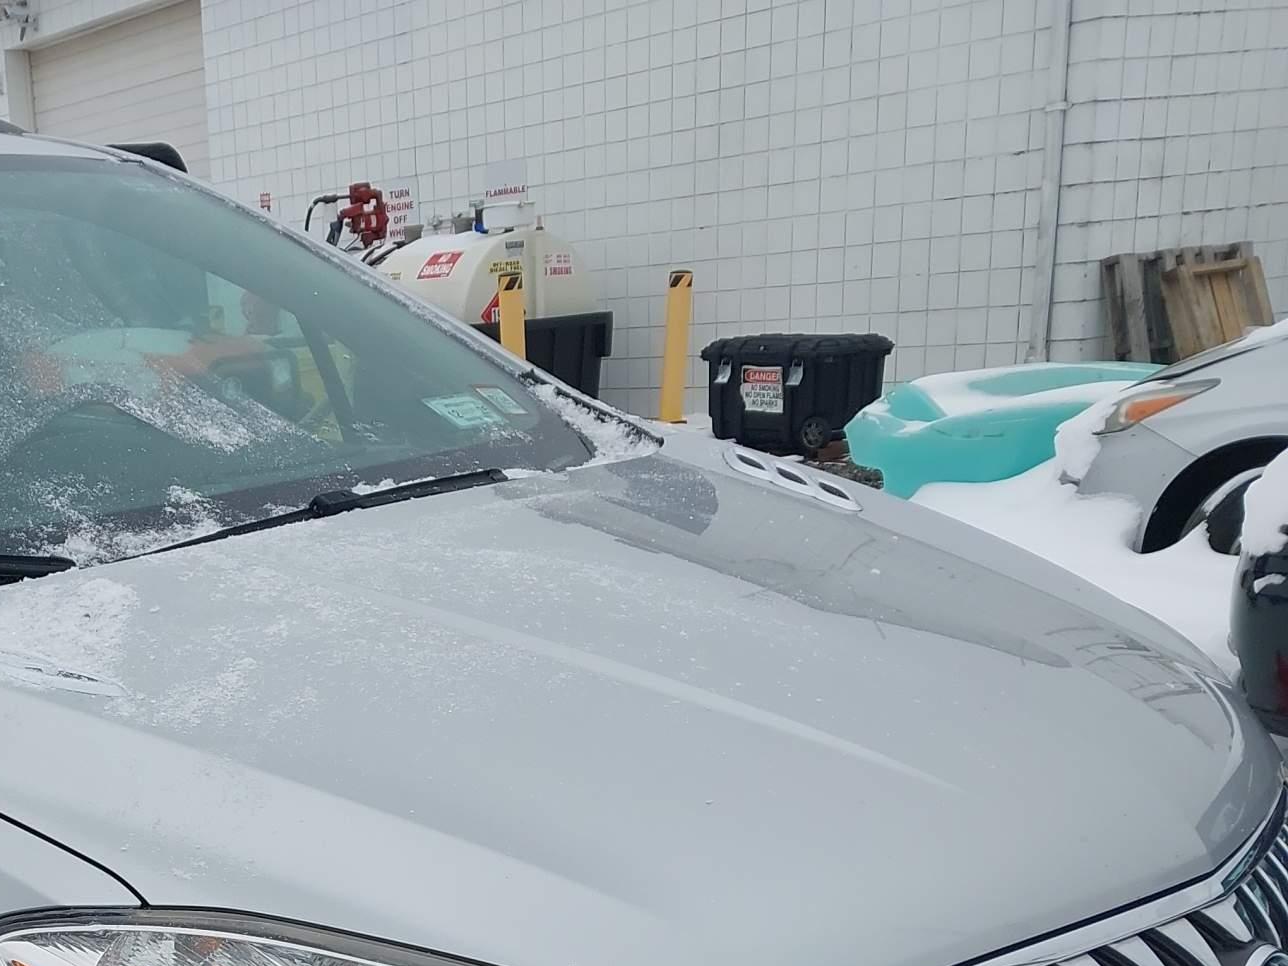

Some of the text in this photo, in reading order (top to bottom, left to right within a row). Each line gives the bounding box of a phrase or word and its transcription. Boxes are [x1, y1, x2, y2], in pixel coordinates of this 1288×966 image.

[389, 188, 410, 199] TURN
[485, 184, 526, 199] FLAMMABLE
[386, 201, 414, 213] ENGINE
[393, 214, 408, 225] OFF
[420, 263, 453, 275] SMOKING
